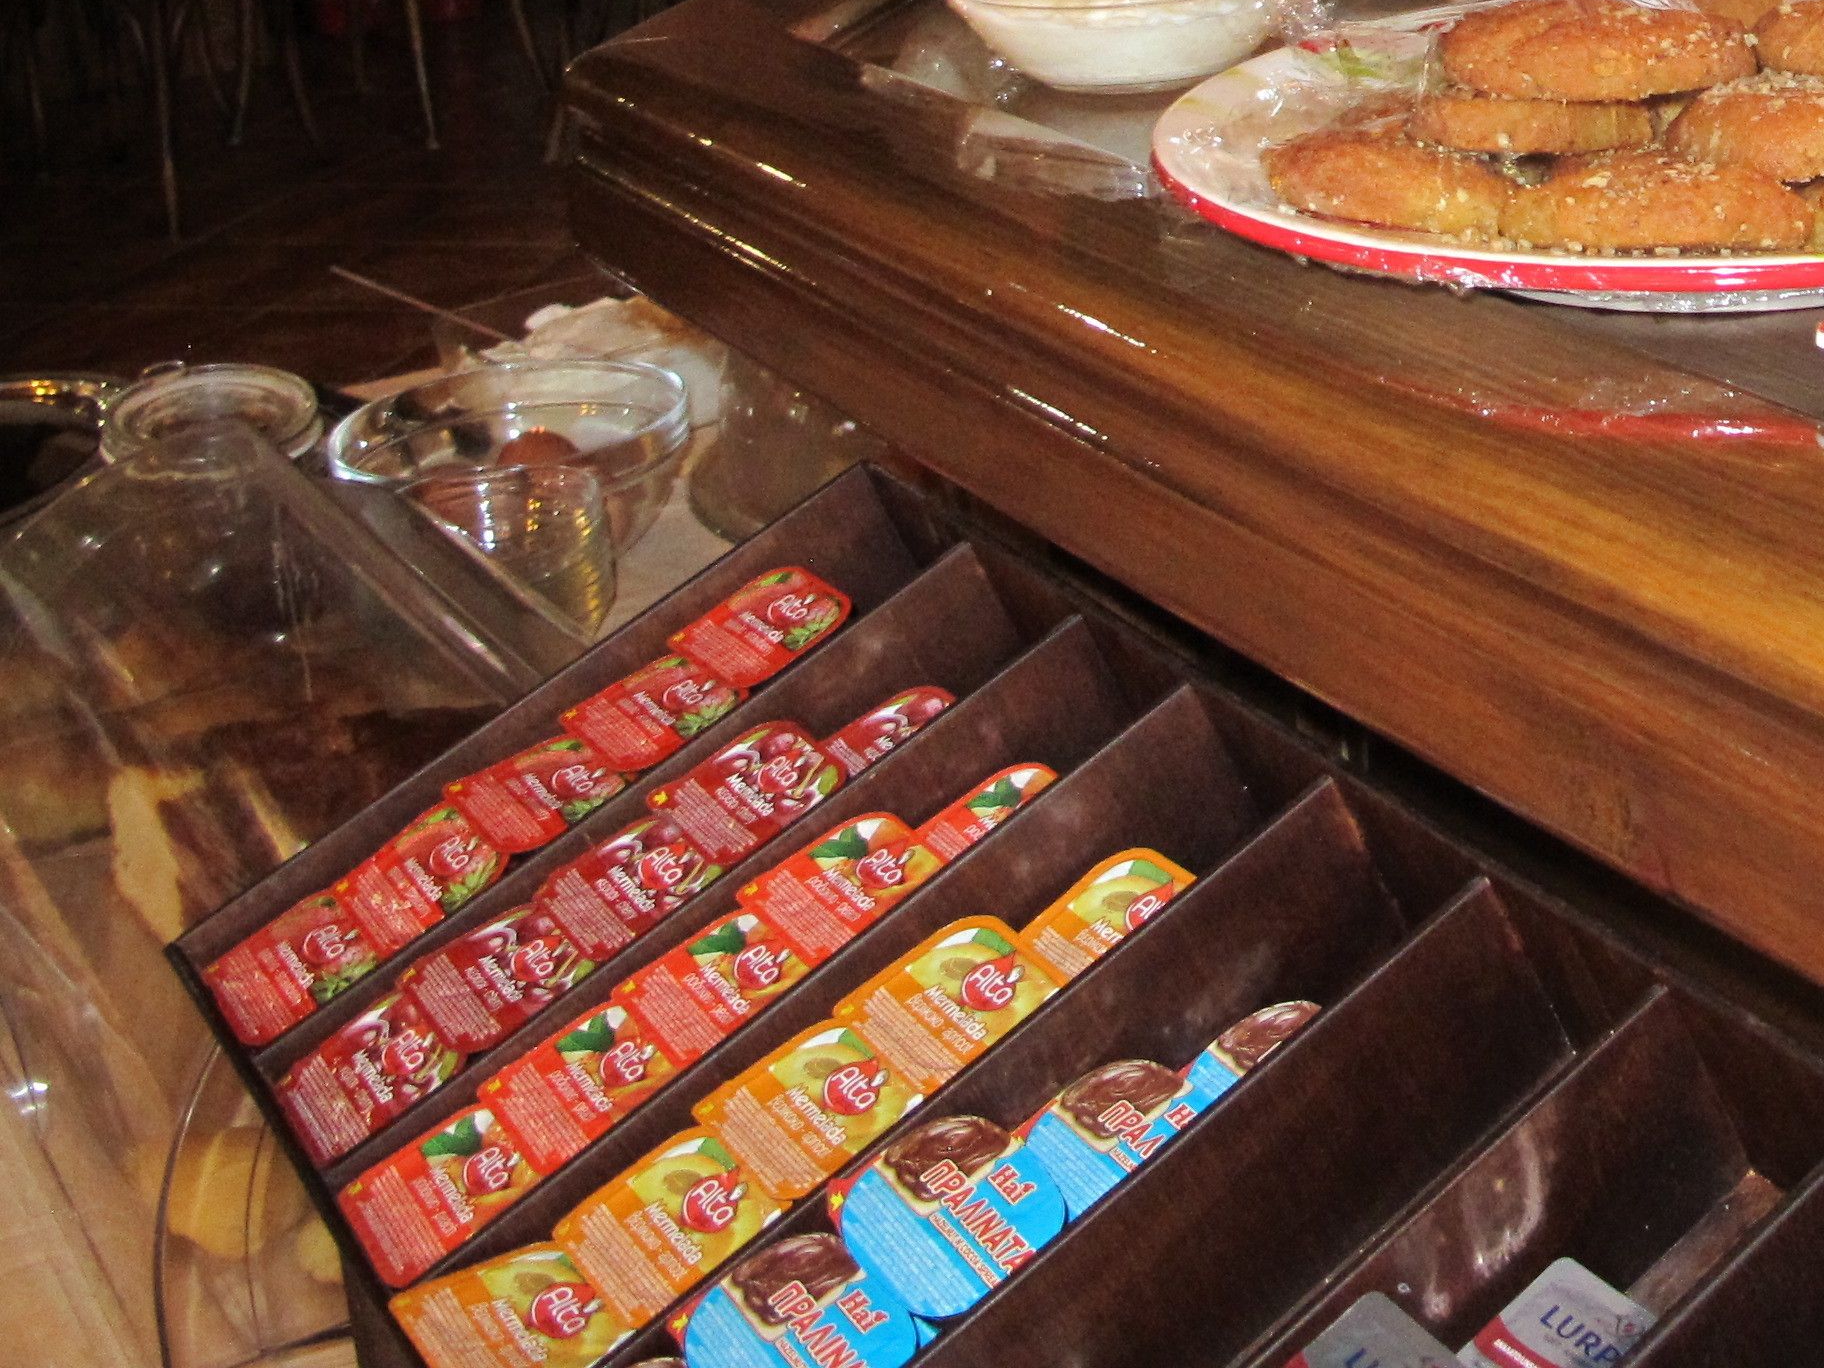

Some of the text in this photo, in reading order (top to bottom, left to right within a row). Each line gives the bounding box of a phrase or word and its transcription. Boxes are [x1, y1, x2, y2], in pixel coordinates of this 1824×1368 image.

[608, 865, 656, 914] Mermelada
[822, 867, 876, 912] Mermelada
[924, 984, 989, 1041] Mermelada
[785, 1083, 847, 1146] Mermelada
[1098, 1100, 1167, 1158] ΠΡΑΛ
[645, 1198, 703, 1264] Mermelada
[919, 1159, 1037, 1275] ΠΡΑΛΙΝΑΤΑ
